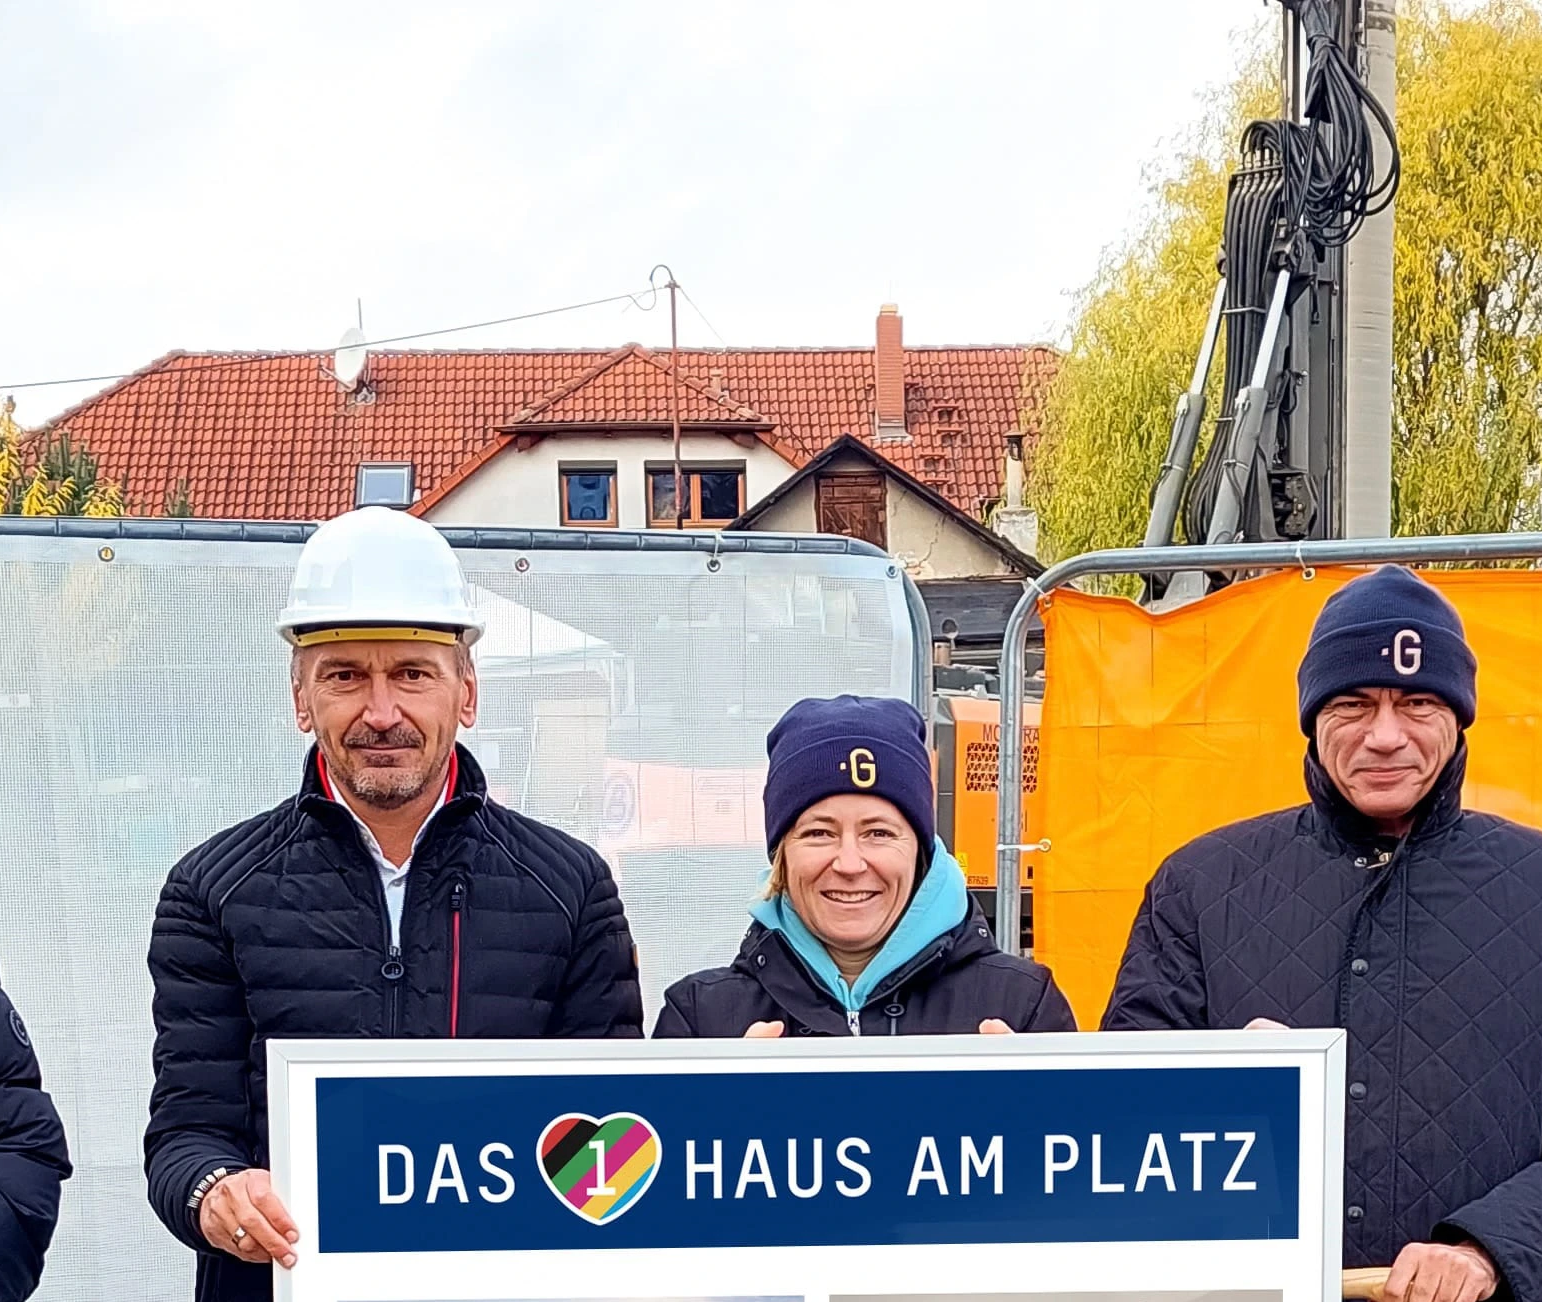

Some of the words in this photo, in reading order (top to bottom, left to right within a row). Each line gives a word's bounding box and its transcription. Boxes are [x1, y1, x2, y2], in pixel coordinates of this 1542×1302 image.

[379, 1143, 515, 1204] DAS
[687, 1138, 872, 1200] HAUS
[907, 1136, 1004, 1196] AM
[1045, 1132, 1257, 1194] PLATZ
